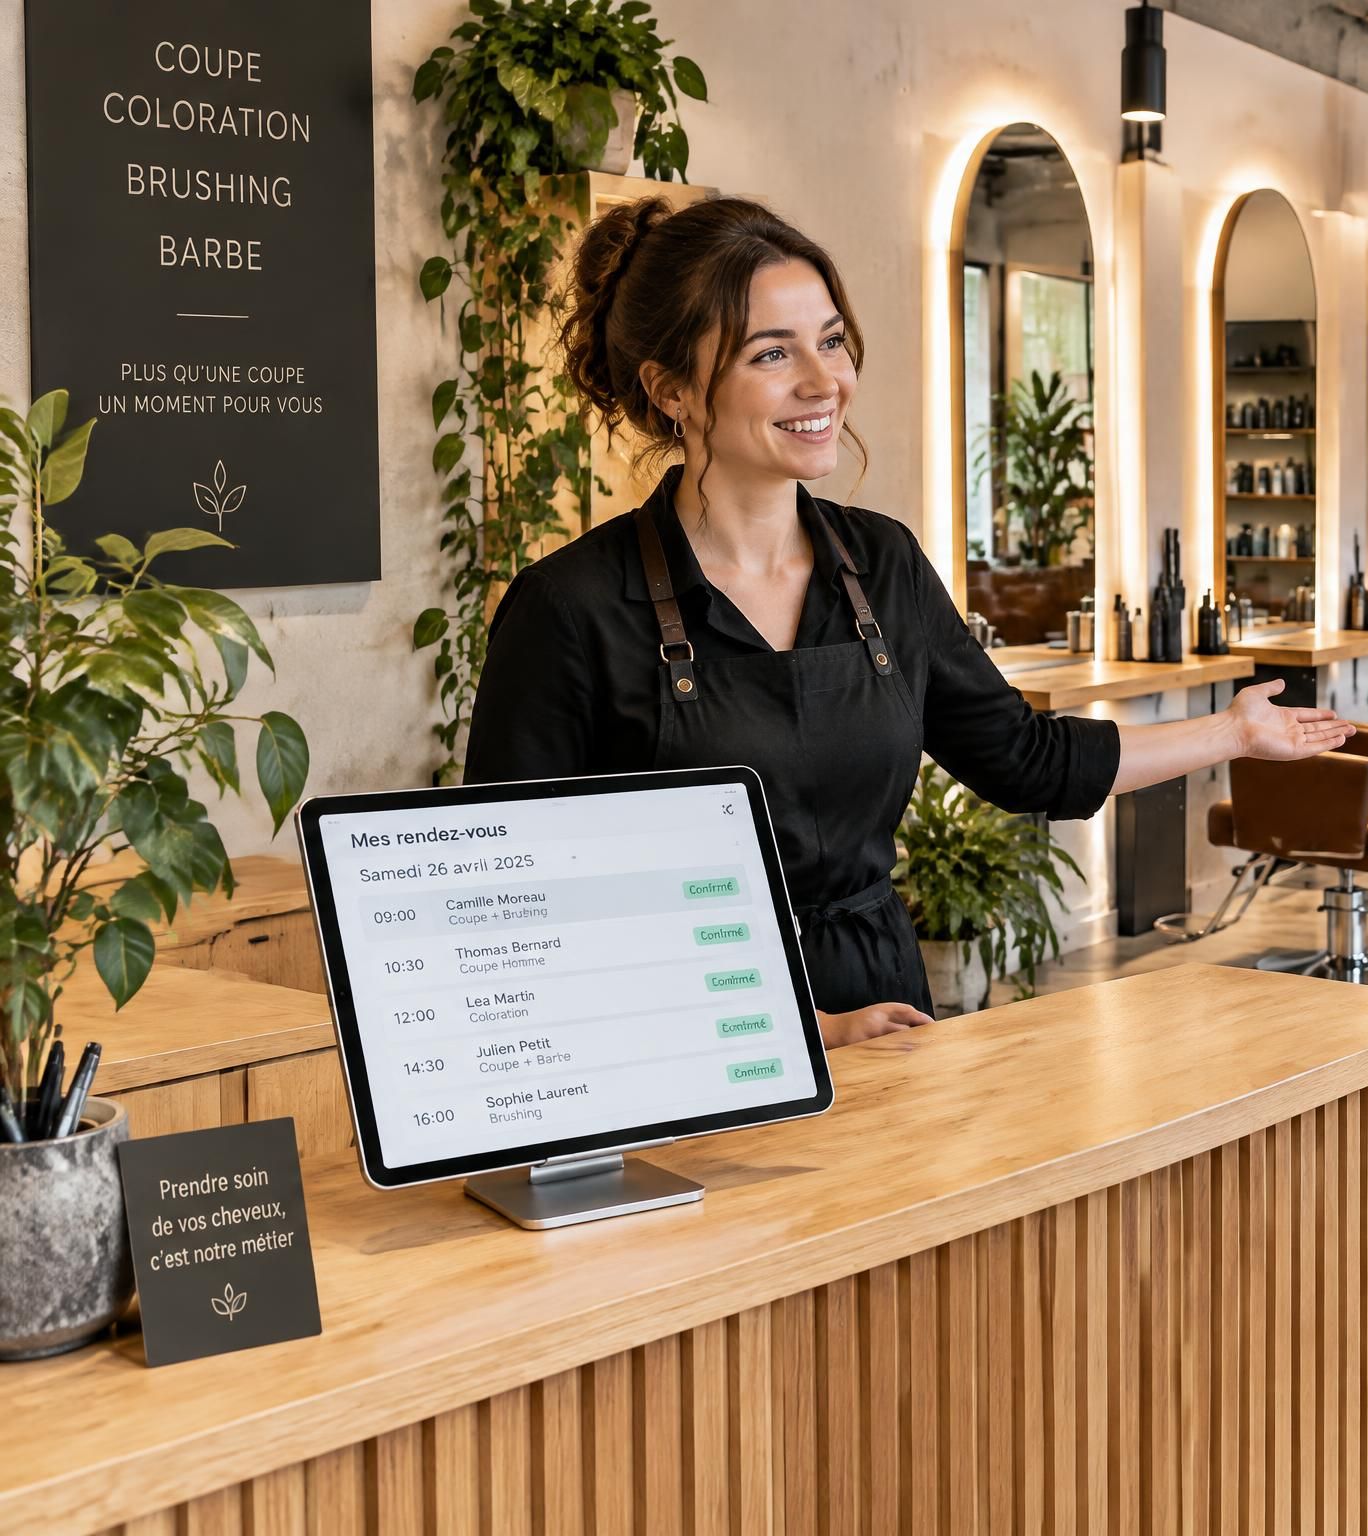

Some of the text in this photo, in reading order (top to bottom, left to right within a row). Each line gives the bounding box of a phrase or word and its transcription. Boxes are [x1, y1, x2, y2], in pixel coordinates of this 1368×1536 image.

[155, 41, 262, 83] COUPE
[103, 92, 311, 144] COLORATION
[127, 163, 292, 208] BRUSHING
[159, 235, 263, 272] BARBE
[120, 363, 167, 382] PLUS
[247, 365, 305, 385] COUPE
[98, 394, 323, 414] UN MOMENT POUR VOUS
[351, 825, 507, 848] Mes rendez-vous
[360, 864, 422, 882] Samedi
[427, 862, 448, 877] 26
[494, 854, 535, 871] 2025
[446, 893, 546, 911] Camille Moreau
[374, 909, 416, 924] 09:00
[449, 914, 488, 926] Coupe
[491, 913, 499, 921] +
[455, 937, 561, 960] Thomas Bernard
[384, 958, 424, 974] 10:30
[459, 962, 499, 974] Coupe
[466, 990, 535, 1008] Lea Martin
[394, 1008, 435, 1025] 12:00
[469, 1007, 529, 1023] Coloration
[476, 1037, 552, 1058] Julien Petit
[403, 1058, 445, 1075] 14:30
[479, 1059, 520, 1073] Coupe
[524, 1058, 533, 1067] +
[486, 1083, 589, 1110] Sophie Laurent
[413, 1109, 455, 1126] 16:00
[489, 1107, 543, 1124] Brushing
[159, 1166, 269, 1200] Prendre soin
[151, 1202, 286, 1237] de vos cheveux,
[194, 1243, 237, 1264] notre
[242, 1230, 294, 1255] métier
